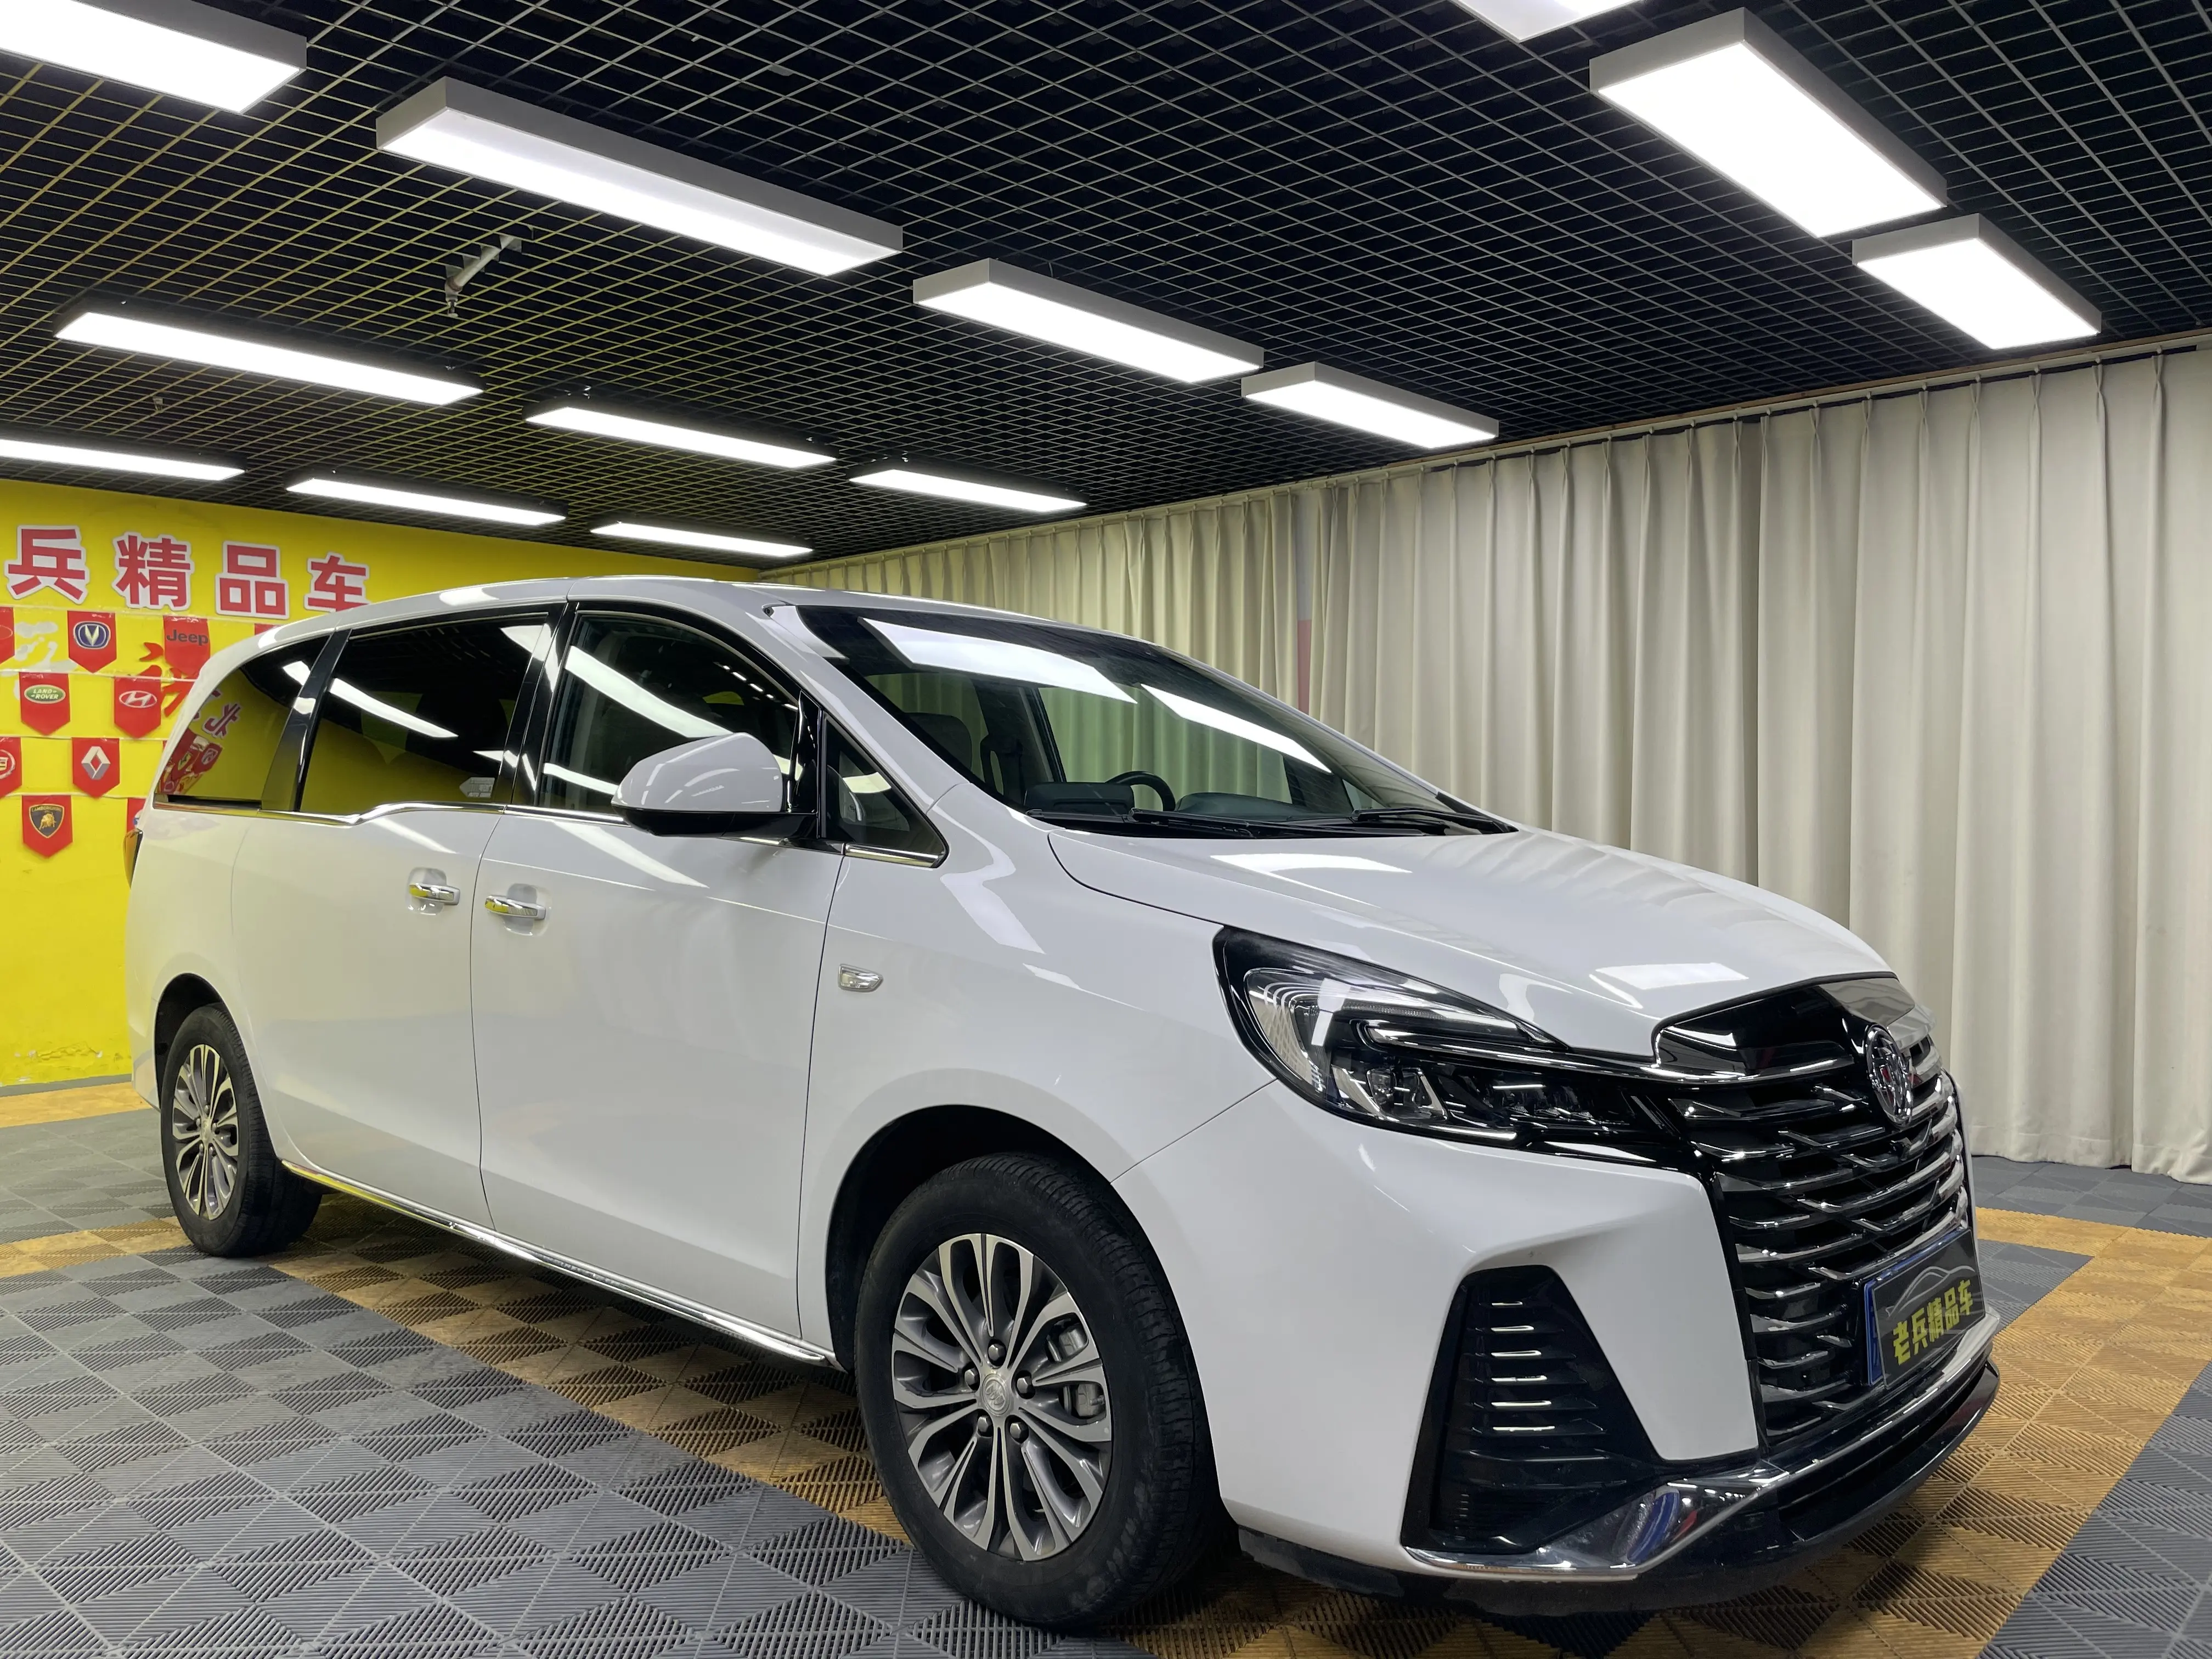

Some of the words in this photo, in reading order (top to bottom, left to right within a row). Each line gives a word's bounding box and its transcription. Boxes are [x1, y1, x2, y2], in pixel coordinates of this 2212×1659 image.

[8, 528, 371, 616] 兵精品车
[166, 629, 208, 646] Jeep
[1893, 1279, 1973, 1365] 老兵精品车
